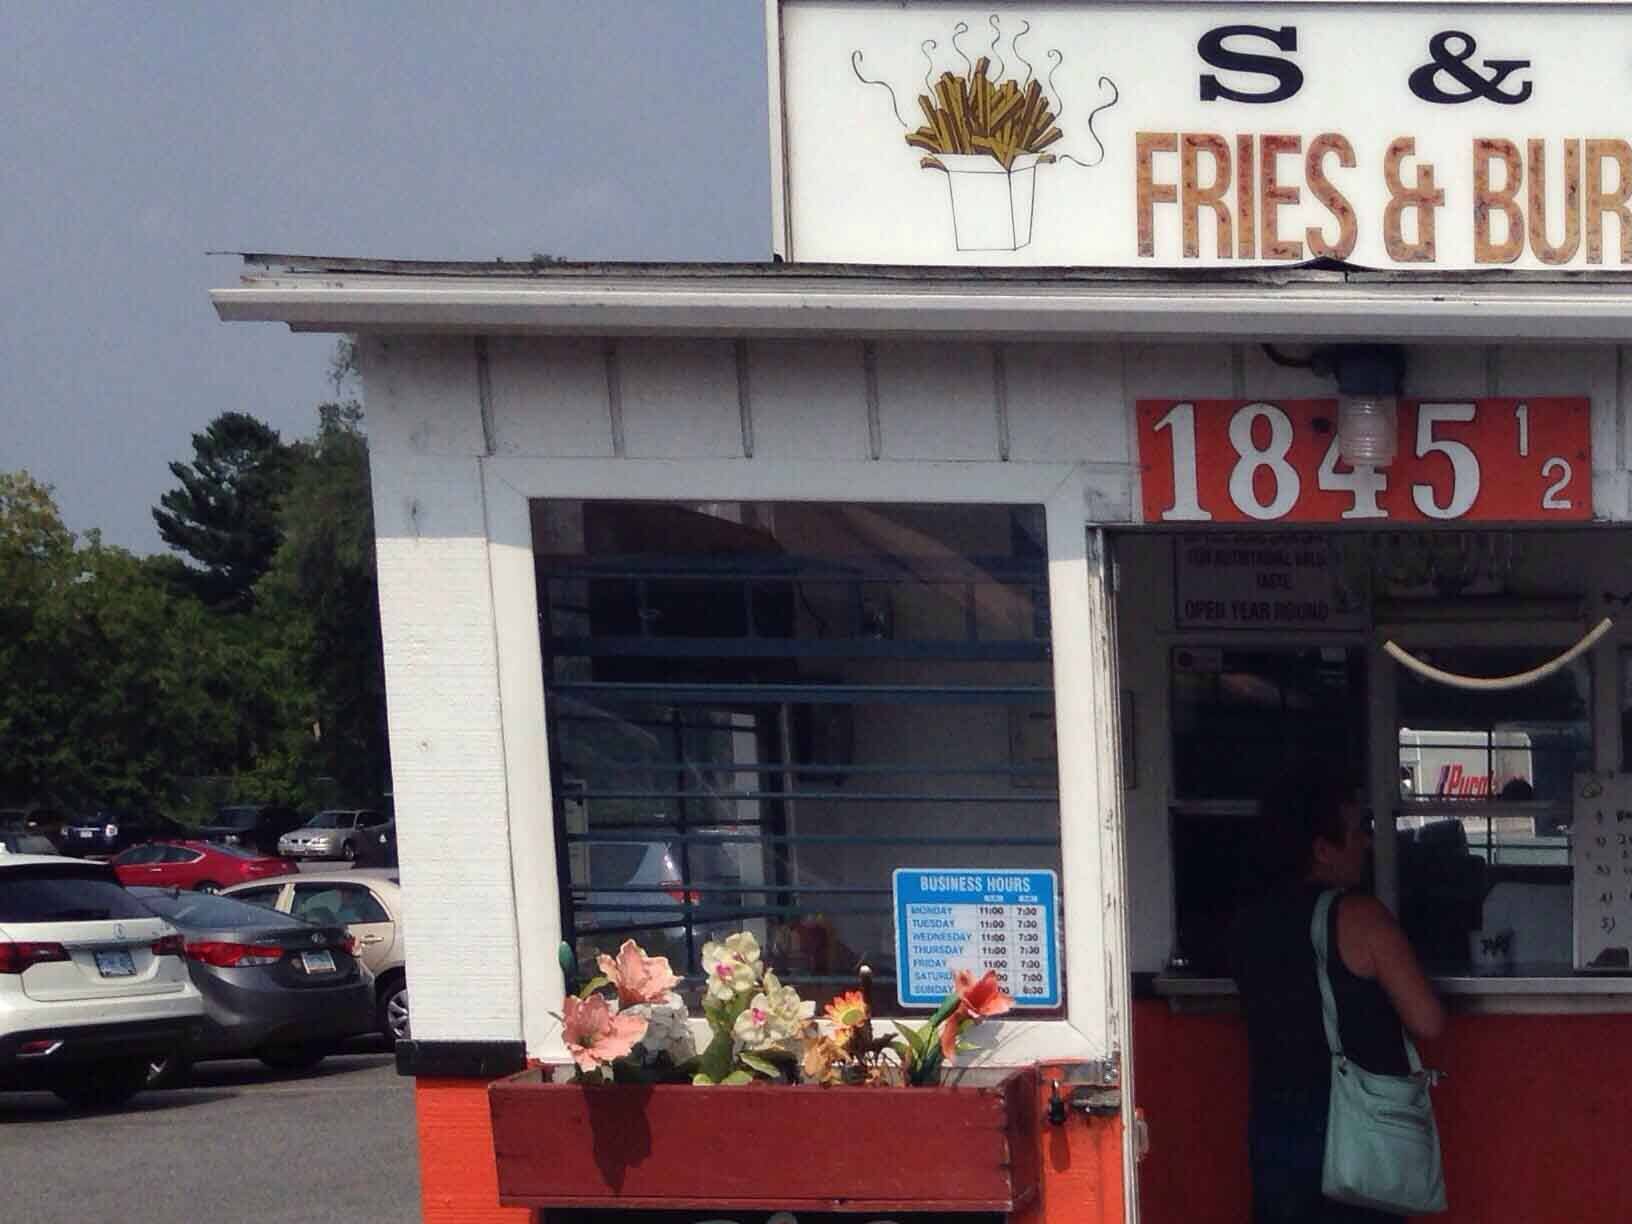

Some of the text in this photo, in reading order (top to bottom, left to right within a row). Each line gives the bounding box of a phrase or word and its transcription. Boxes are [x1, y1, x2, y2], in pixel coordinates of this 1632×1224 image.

[1197, 25, 1304, 104] S
[1408, 30, 1533, 106] &
[1135, 130, 1358, 262] FRIES
[1382, 133, 1447, 263] &
[1153, 402, 1481, 521] 1845
[920, 875, 1032, 893] BUSINESS HOURS
[911, 907, 953, 915] MONDAY
[911, 919, 955, 929] TUESDAY
[912, 932, 972, 942] WEDNESDAY
[913, 945, 964, 956] THURSDAY
[913, 959, 947, 968] FRIDAY
[914, 973, 954, 982] SATURD
[914, 985, 954, 995] SUNDAY
